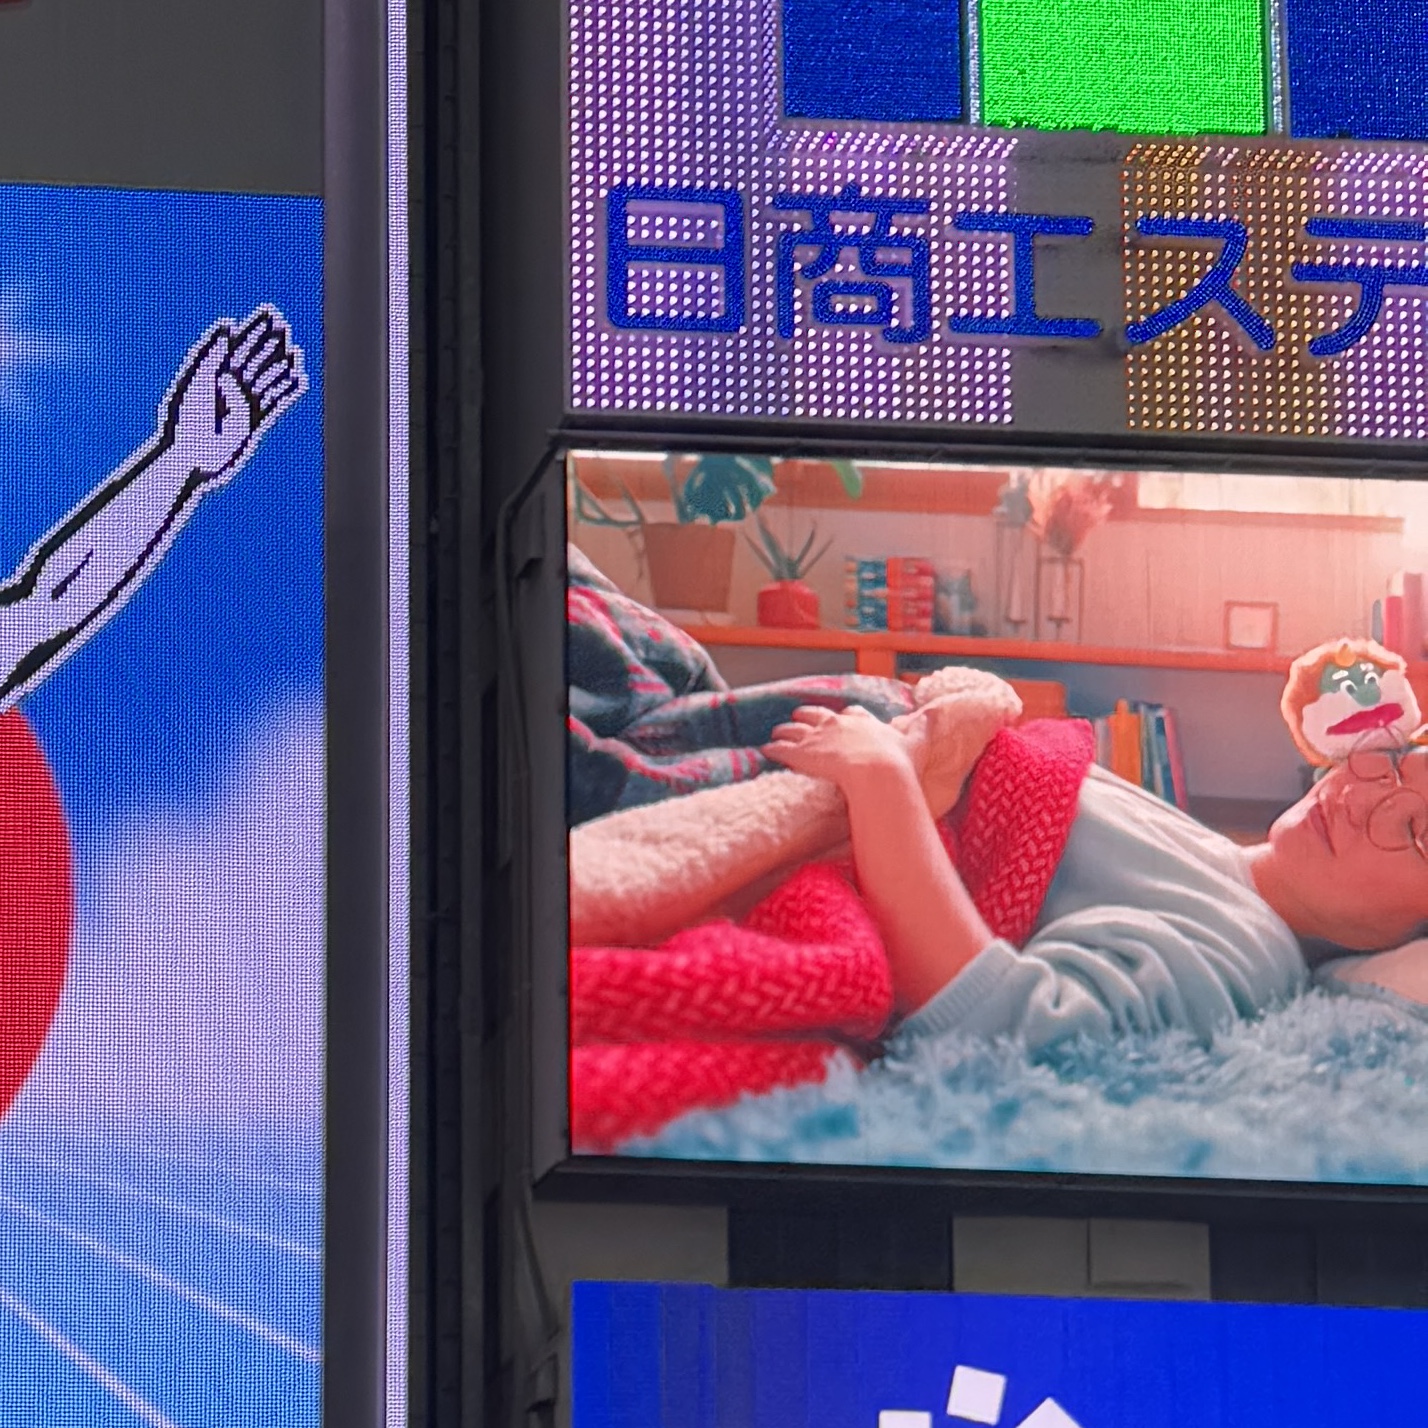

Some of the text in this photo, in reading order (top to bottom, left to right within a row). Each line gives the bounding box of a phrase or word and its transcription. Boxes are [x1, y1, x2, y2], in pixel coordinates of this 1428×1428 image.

[605, 184, 1428, 357] 日商エステ
